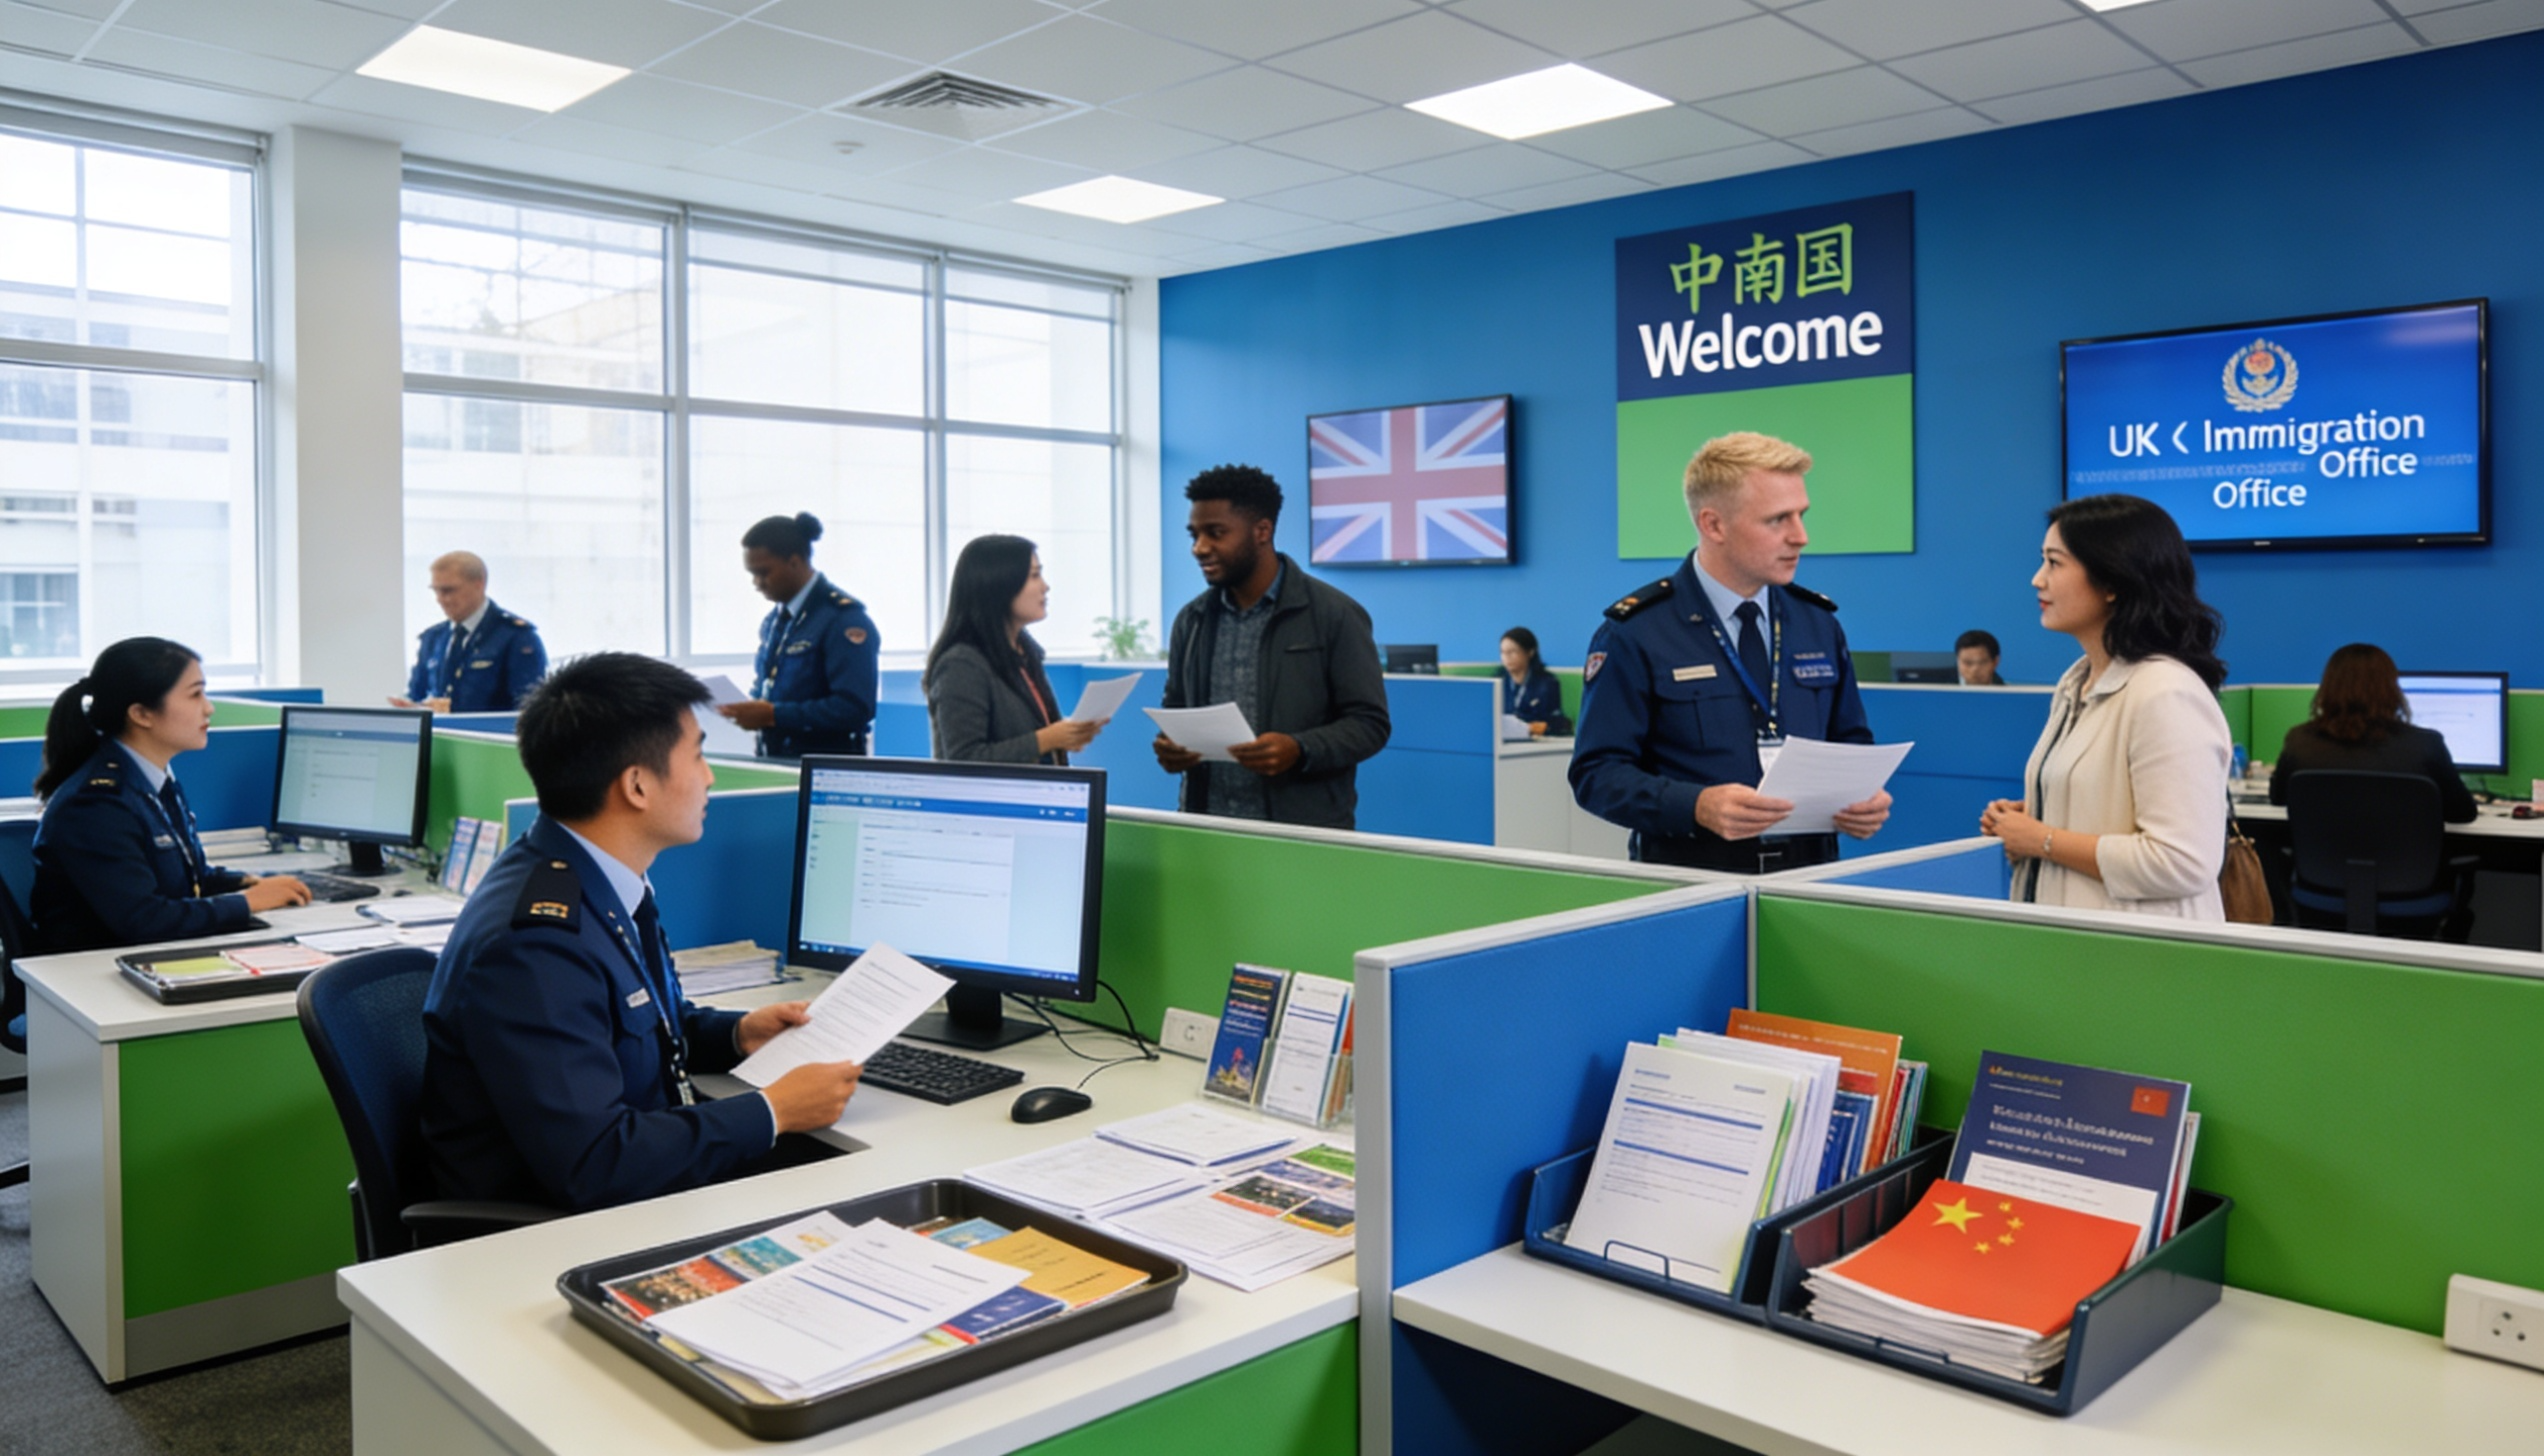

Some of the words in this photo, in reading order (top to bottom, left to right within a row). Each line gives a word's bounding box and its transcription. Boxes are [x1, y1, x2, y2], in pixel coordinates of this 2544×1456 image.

[1669, 222, 1853, 314] 中南国
[1638, 311, 1884, 379] Welcome
[2109, 422, 2161, 458] UK
[2203, 409, 2426, 455] Immigration
[2318, 446, 2418, 479] Office
[2212, 477, 2308, 509] Office
